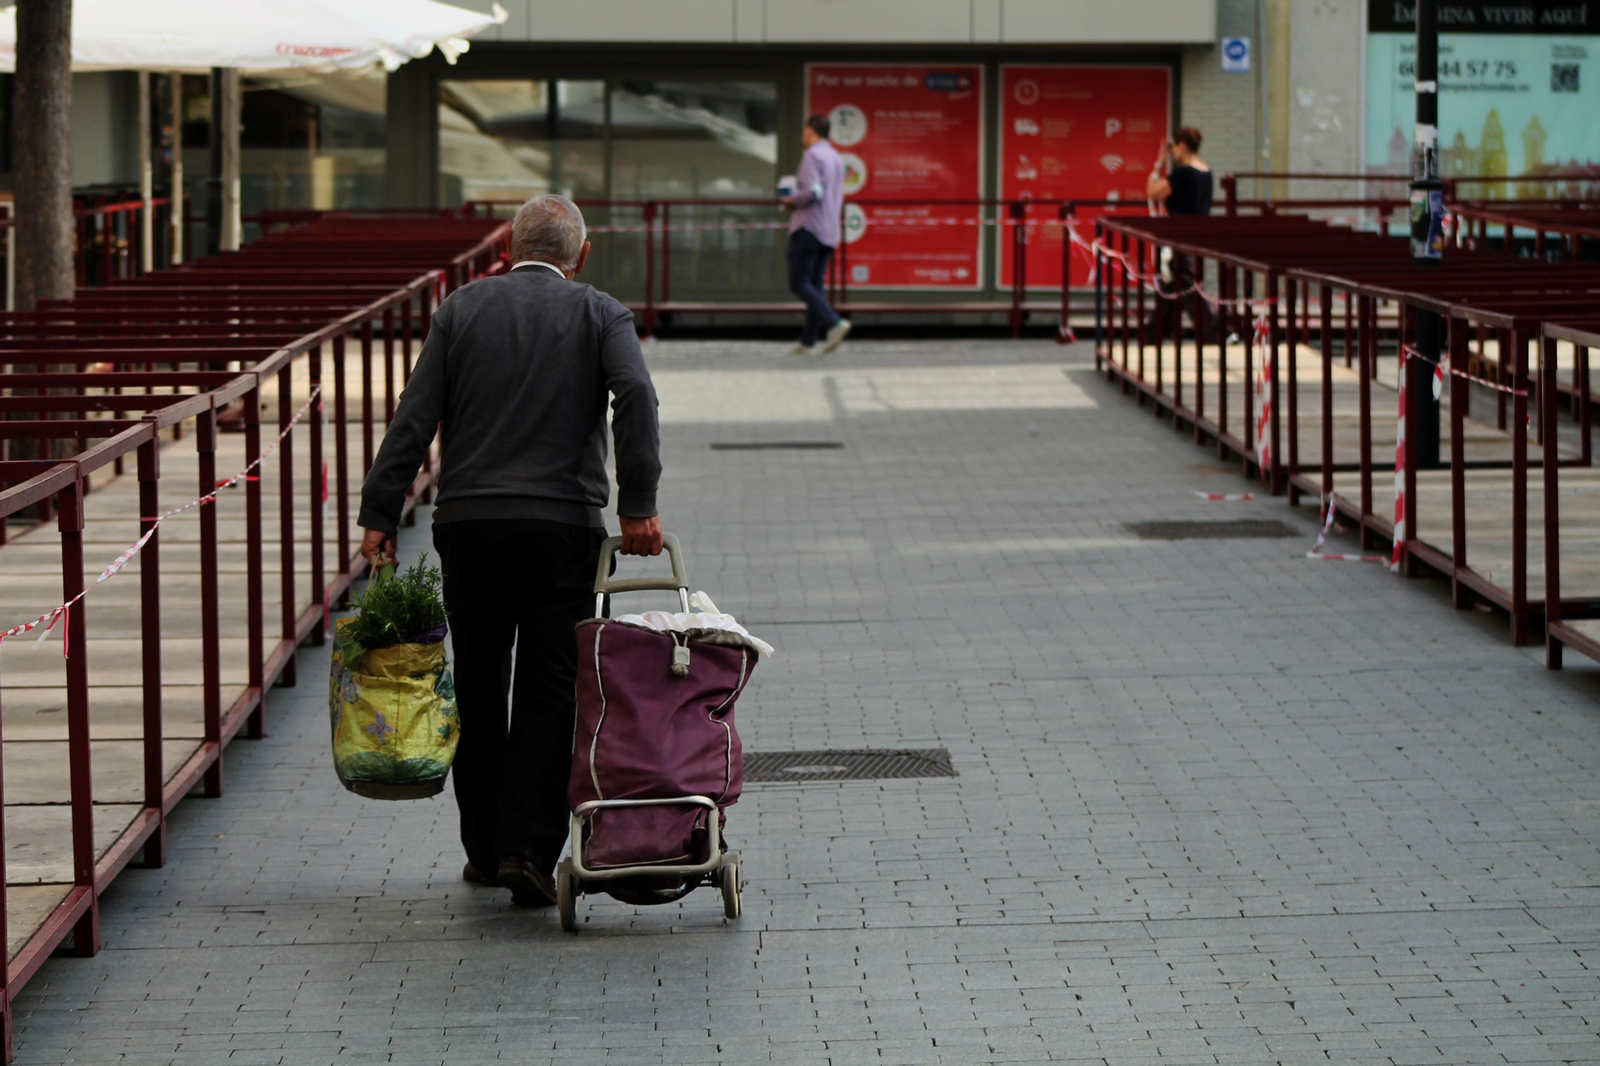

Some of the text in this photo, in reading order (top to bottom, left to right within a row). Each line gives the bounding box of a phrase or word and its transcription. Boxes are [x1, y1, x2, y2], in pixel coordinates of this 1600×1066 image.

[1481, 5, 1535, 25] VIVIR
[1539, 2, 1588, 26] AQUÍ
[1466, 60, 1489, 79] 57
[1493, 60, 1517, 79] 75
